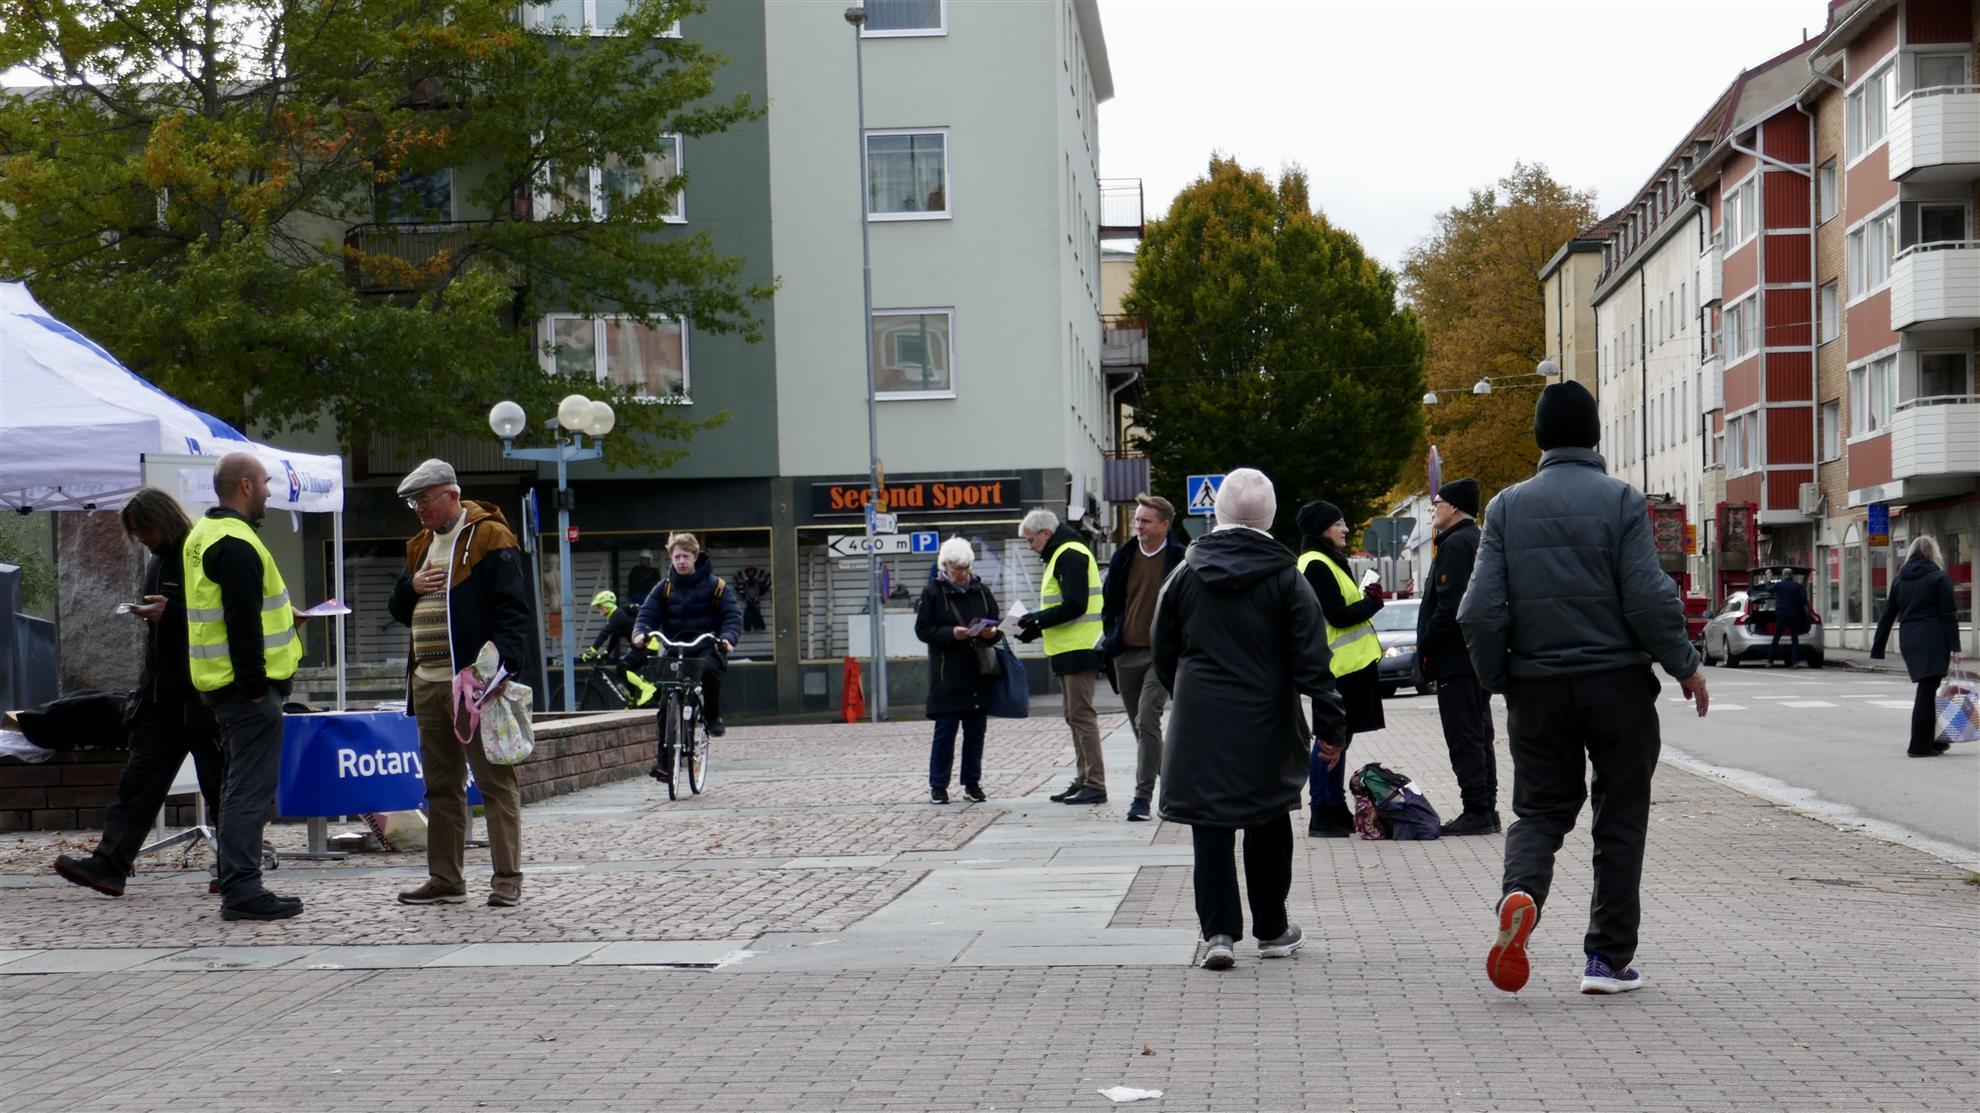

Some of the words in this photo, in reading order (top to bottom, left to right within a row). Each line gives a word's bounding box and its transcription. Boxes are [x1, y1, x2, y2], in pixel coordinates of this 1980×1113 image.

[932, 481, 1002, 508] Sport
[848, 538, 884, 551] 400
[896, 540, 908, 549] m
[919, 534, 932, 550] P
[337, 749, 424, 779] Rotary
